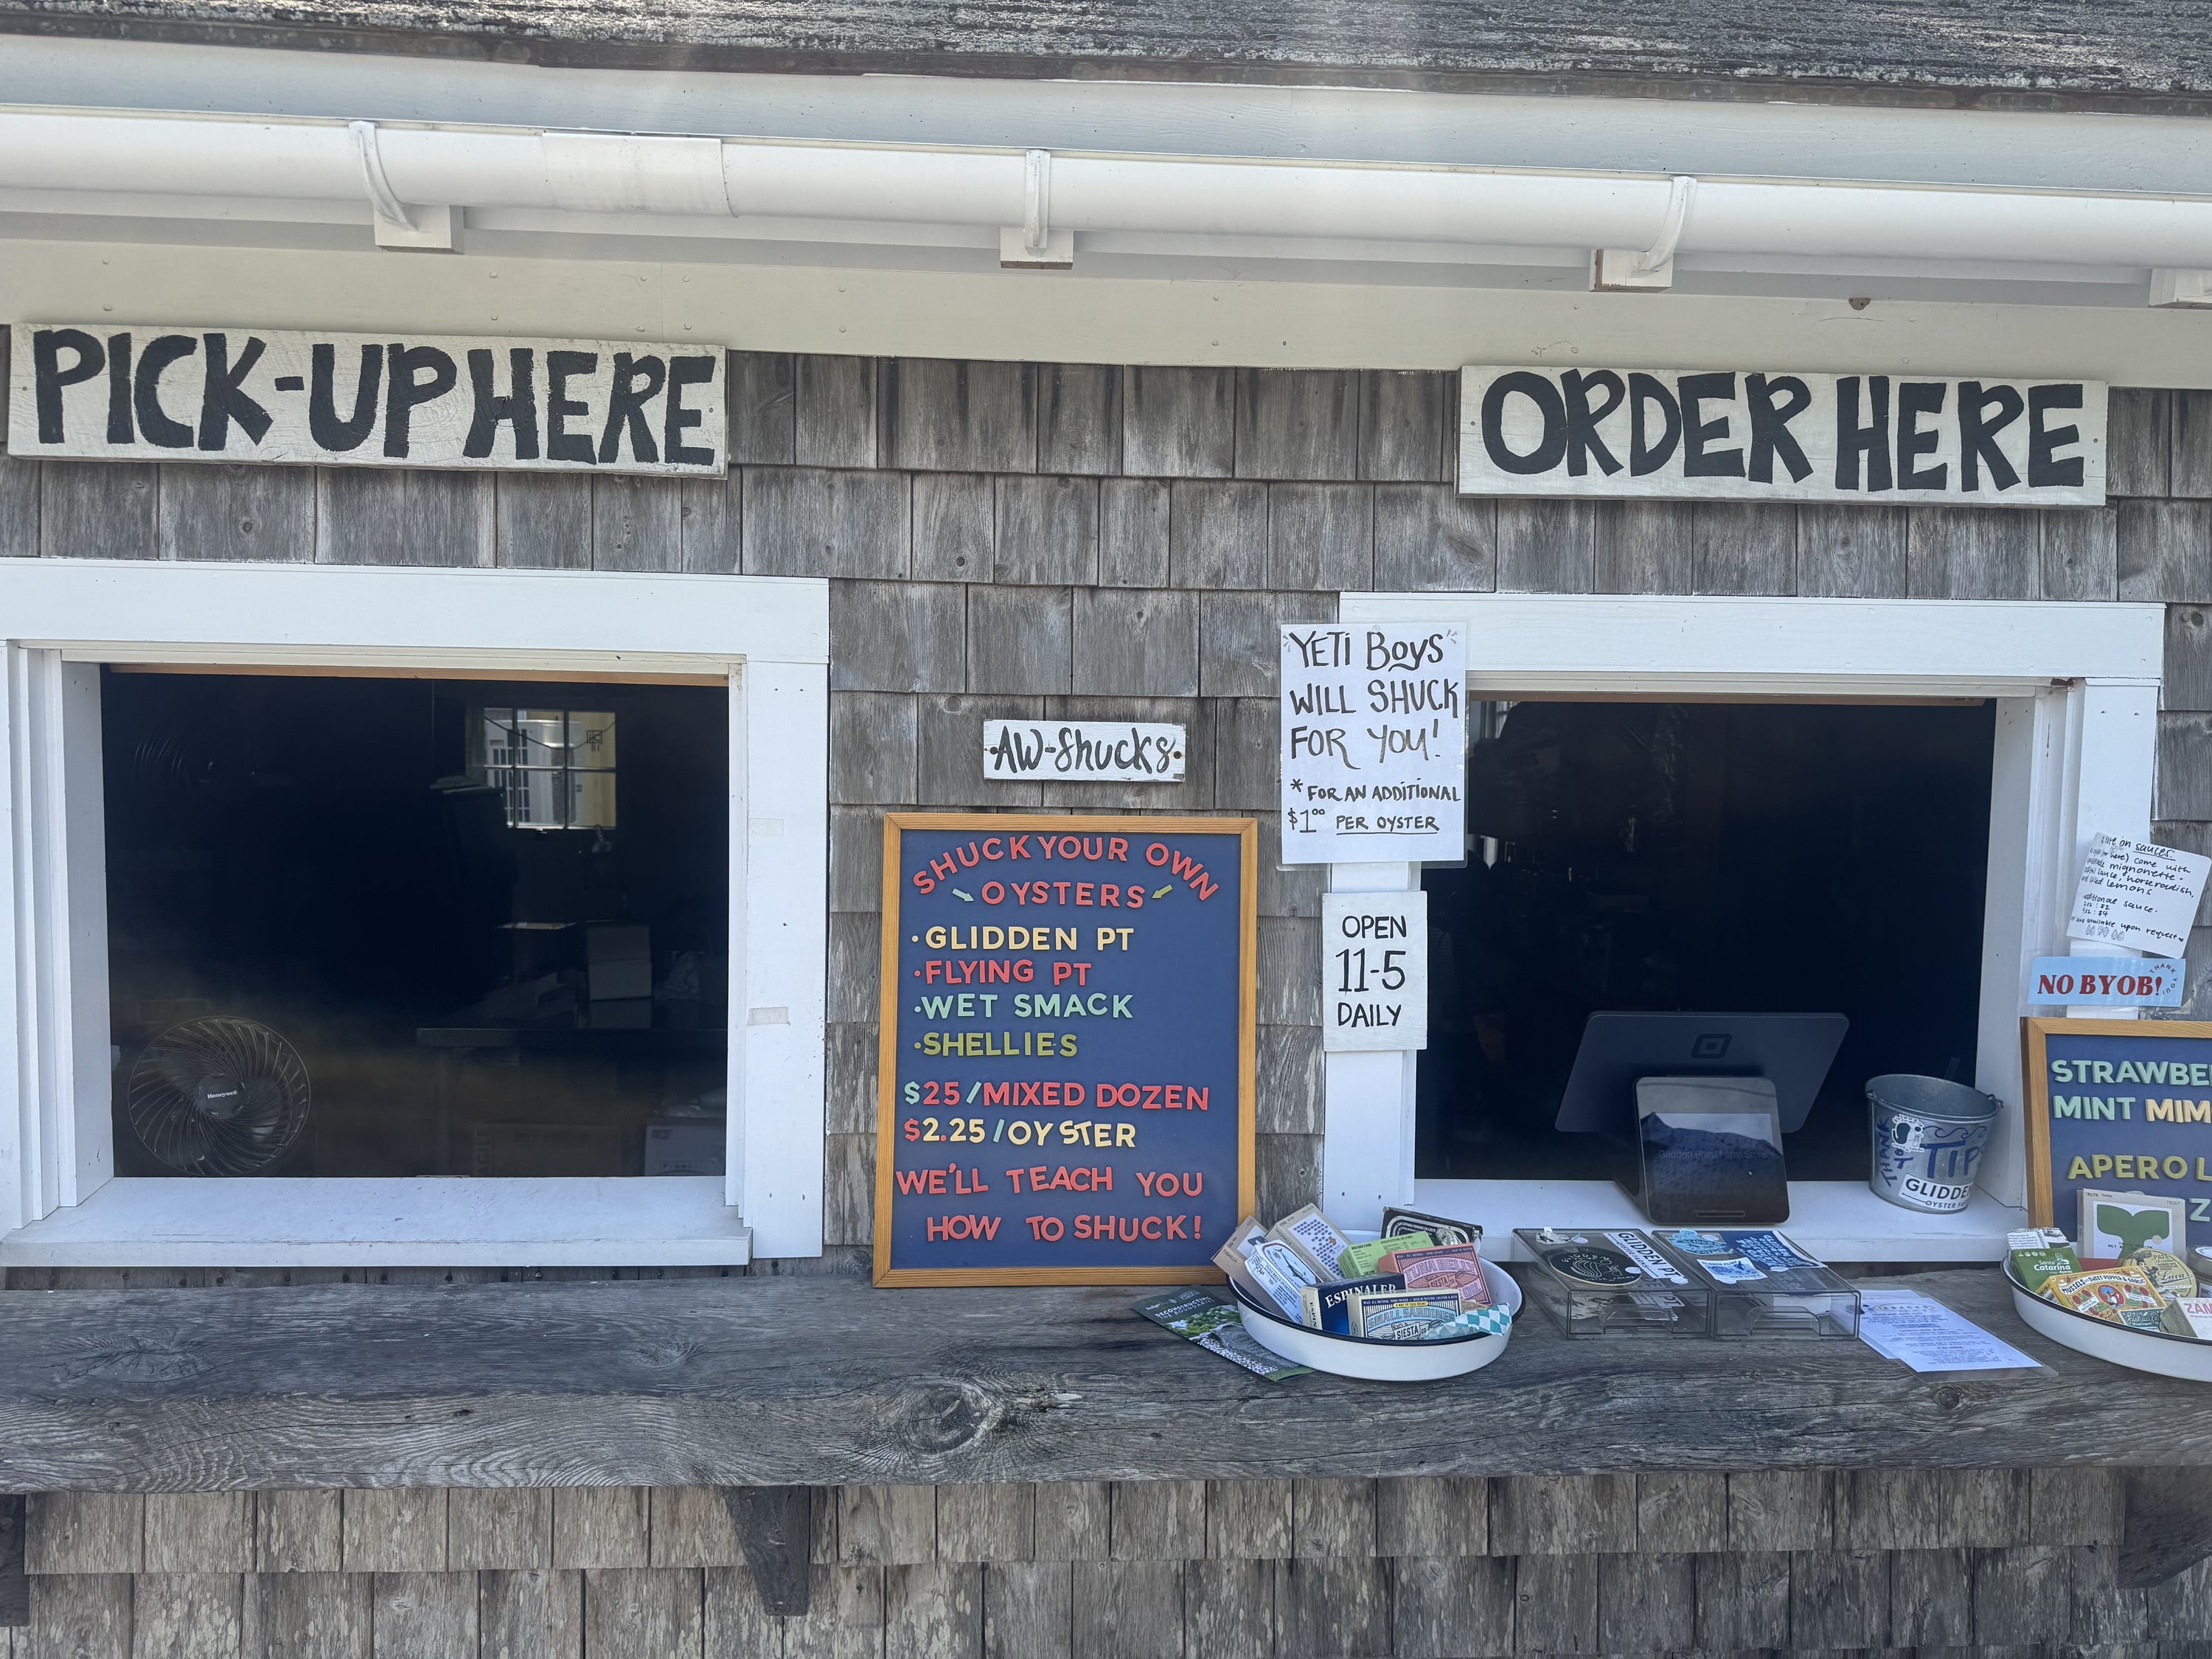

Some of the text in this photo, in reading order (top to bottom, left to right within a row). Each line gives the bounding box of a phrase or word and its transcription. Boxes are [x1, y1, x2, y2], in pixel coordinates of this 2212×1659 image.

[33, 330, 716, 465] PICK-UP HERE
[1481, 368, 2084, 492] ORDER HERE
[1290, 630, 1443, 672] YETI Boys
[1290, 678, 1458, 718] WILL SHUCK
[1291, 718, 1441, 770] FOR YOU!
[1345, 785, 1366, 802] AN
[1372, 778, 1461, 803] ADDITIONAL
[1336, 815, 1368, 830] PER
[1377, 815, 1440, 832] OYSTER
[913, 835, 1220, 901] SHUCK YOUR OWN
[2134, 858, 2157, 868] come
[2166, 863, 2191, 874] with
[981, 881, 1145, 908] OYSTERS
[2107, 879, 2152, 896] lemons
[925, 926, 1134, 951] GLIDDEN PT
[1342, 915, 1407, 939] OPEN
[925, 959, 1091, 986] FLYING PT
[1335, 947, 1406, 992] 11-5
[2149, 963, 2177, 974] THANK
[2037, 975, 2163, 996] NO BYOB!
[921, 993, 1133, 1019] WET SMACK
[1338, 1002, 1402, 1028] DAILY
[923, 1032, 1077, 1057] SHELLIES
[2050, 1060, 2212, 1086] STRAWBE
[207, 1090, 237, 1099] Honeywell
[1096, 1083, 1209, 1111] DOZEN
[2053, 1095, 2135, 1121] MINT
[1877, 1118, 1897, 1187] THANK
[896, 1163, 1203, 1197] WE'LL TEACH YOU
[1905, 1178, 1969, 1200] GLIDDE
[2188, 1198, 2211, 1222] Z
[927, 1215, 1001, 1242] HOW
[1026, 1215, 1064, 1242] TO
[1074, 1215, 1201, 1242] SHUCK!
[1618, 1233, 1681, 1278] GLIDDEN PT
[1404, 1259, 1476, 1282] TUNA BELLY
[1325, 1284, 1396, 1308] ESPINALER
[1463, 1282, 1481, 1298] OIL
[2062, 1279, 2085, 1294] MUSSELS
[1368, 1308, 1455, 1328] SMALL SARDINES
[1397, 1325, 1419, 1339] SIESTA
